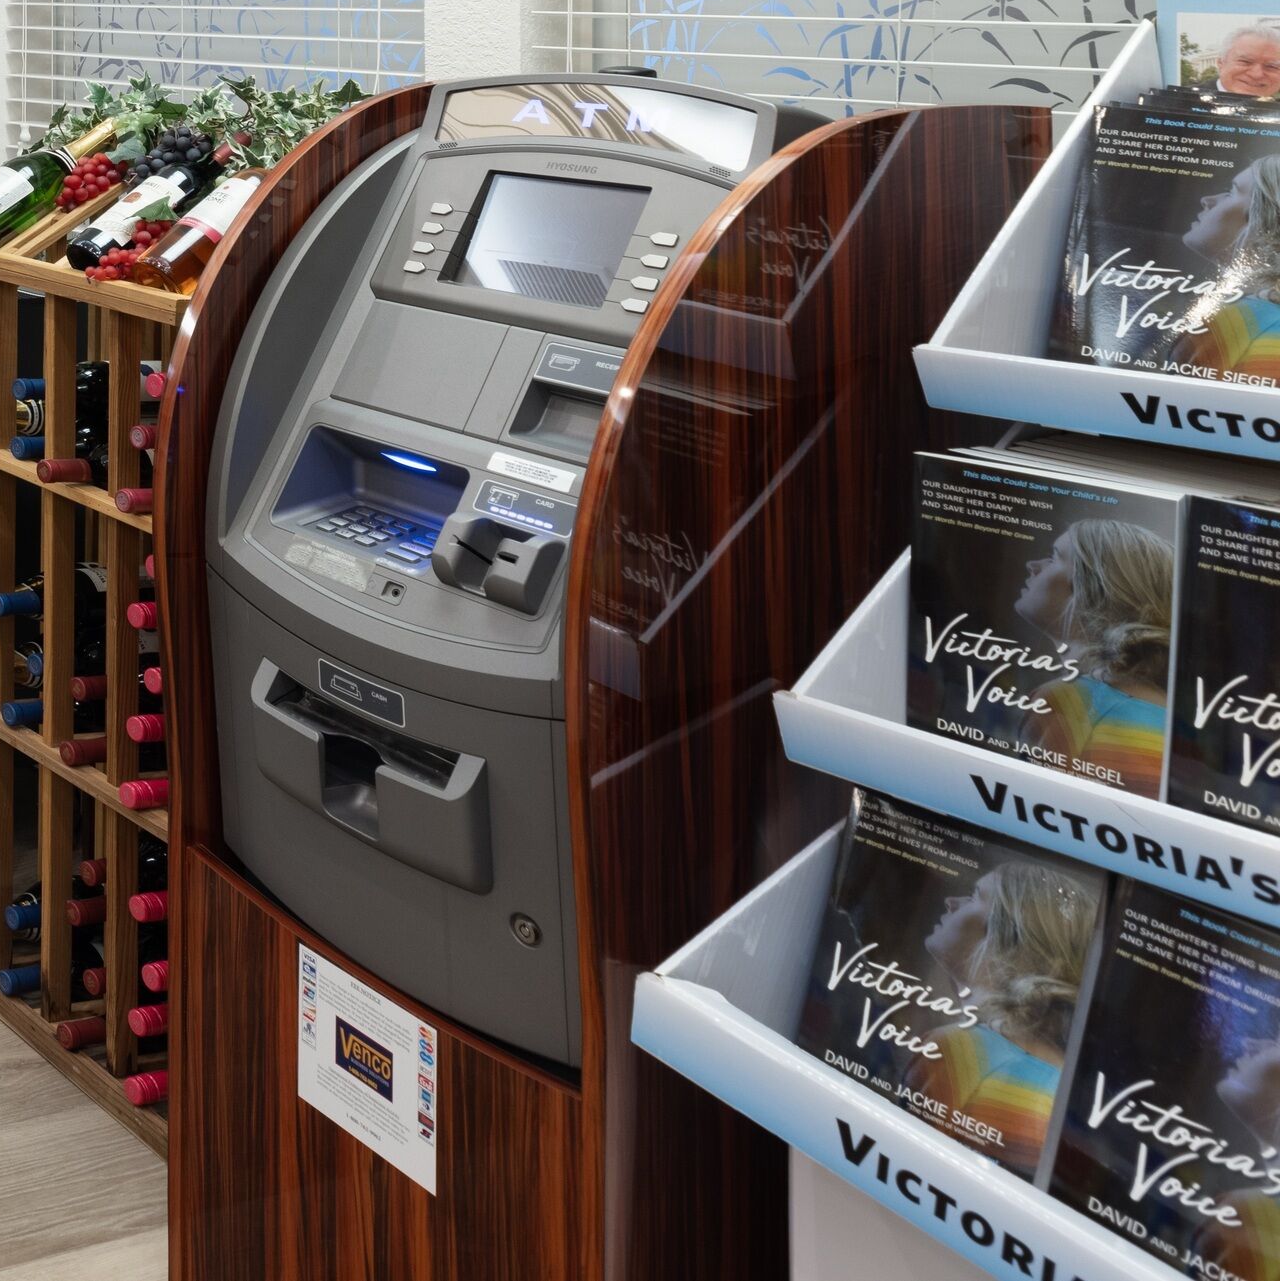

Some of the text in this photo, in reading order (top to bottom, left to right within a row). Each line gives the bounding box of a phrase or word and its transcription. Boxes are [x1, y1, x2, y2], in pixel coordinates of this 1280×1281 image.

[1098, 137, 1194, 154] TO SHARE HER DIARY
[1100, 128, 1238, 149] OUR DAUGHTER'S DYING WISH
[1144, 117, 1258, 136] This Book Could Save Your
[546, 161, 598, 175] HYOSUNG
[1096, 146, 1234, 169] AND SAVE LIVES FROM DRUGS
[1107, 159, 1130, 169] Words
[1131, 162, 1149, 170] from
[1149, 164, 1177, 175] Beyond
[1191, 170, 1214, 179] Grave
[1077, 247, 1244, 303] Victorias
[1115, 290, 1209, 339] Voice
[1081, 345, 1279, 389] DAVID AND JACKIE SIEGEL
[535, 498, 555, 509] CARD
[925, 613, 1080, 682] Victoria's
[371, 690, 388, 703] CASH
[965, 663, 1052, 714] Voice
[937, 717, 1126, 787] DAVID AND JACKIE SIEGEL
[1204, 790, 1261, 819] DAVID
[969, 773, 1280, 907] VICTORIA'S
[303, 952, 316, 965] VISA
[827, 942, 979, 1028] Victoria's
[339, 1026, 392, 1081] Venco
[856, 997, 943, 1060] Voice
[824, 1048, 1006, 1147] DAVID AND JACKIE SIEGEL
[1088, 1071, 1280, 1195] Victoria's
[1129, 1142, 1243, 1227] Voice
[1088, 1196, 1178, 1257] DAVID AND
